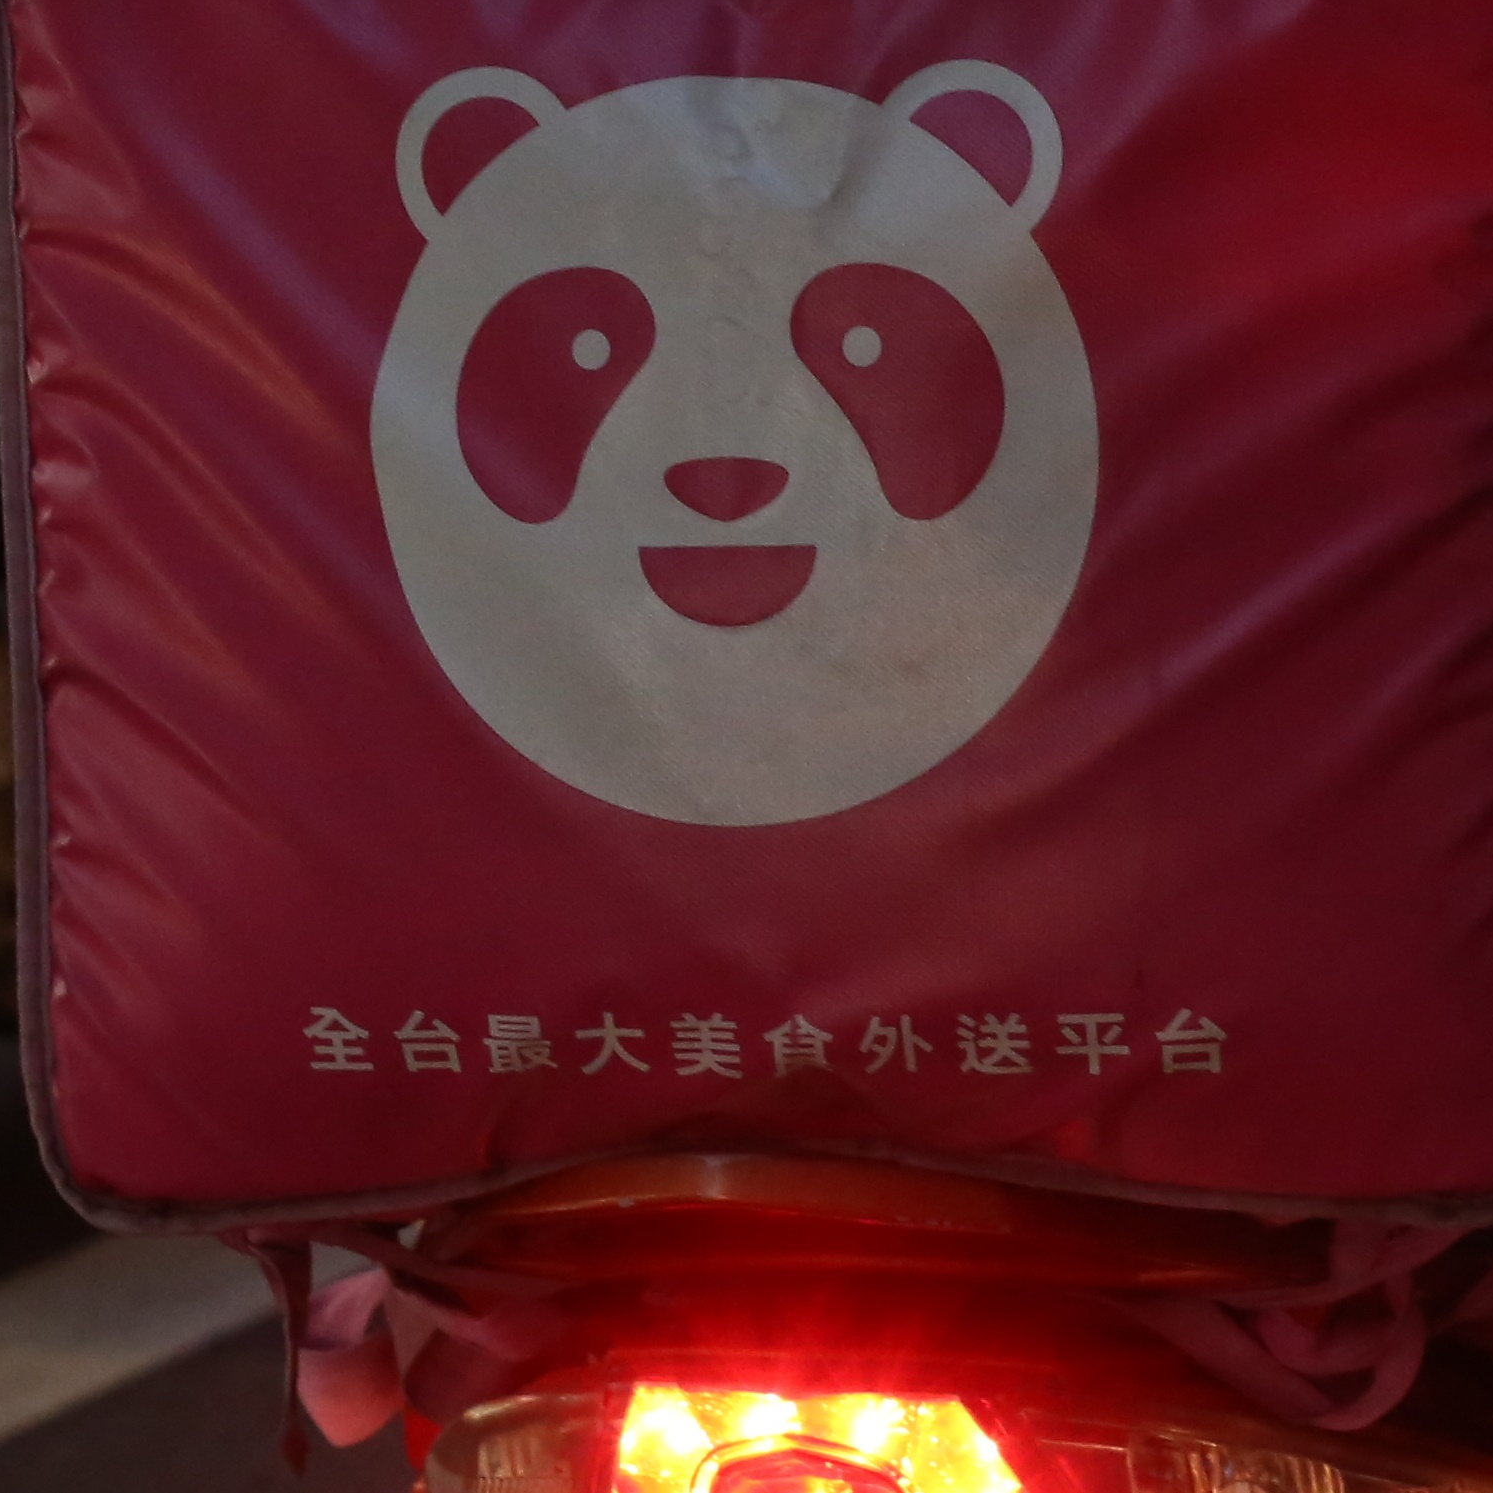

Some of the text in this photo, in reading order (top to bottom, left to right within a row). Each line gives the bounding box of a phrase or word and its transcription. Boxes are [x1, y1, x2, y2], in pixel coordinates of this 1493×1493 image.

[302, 1005, 1229, 1079] 全台最大美食外送平台
